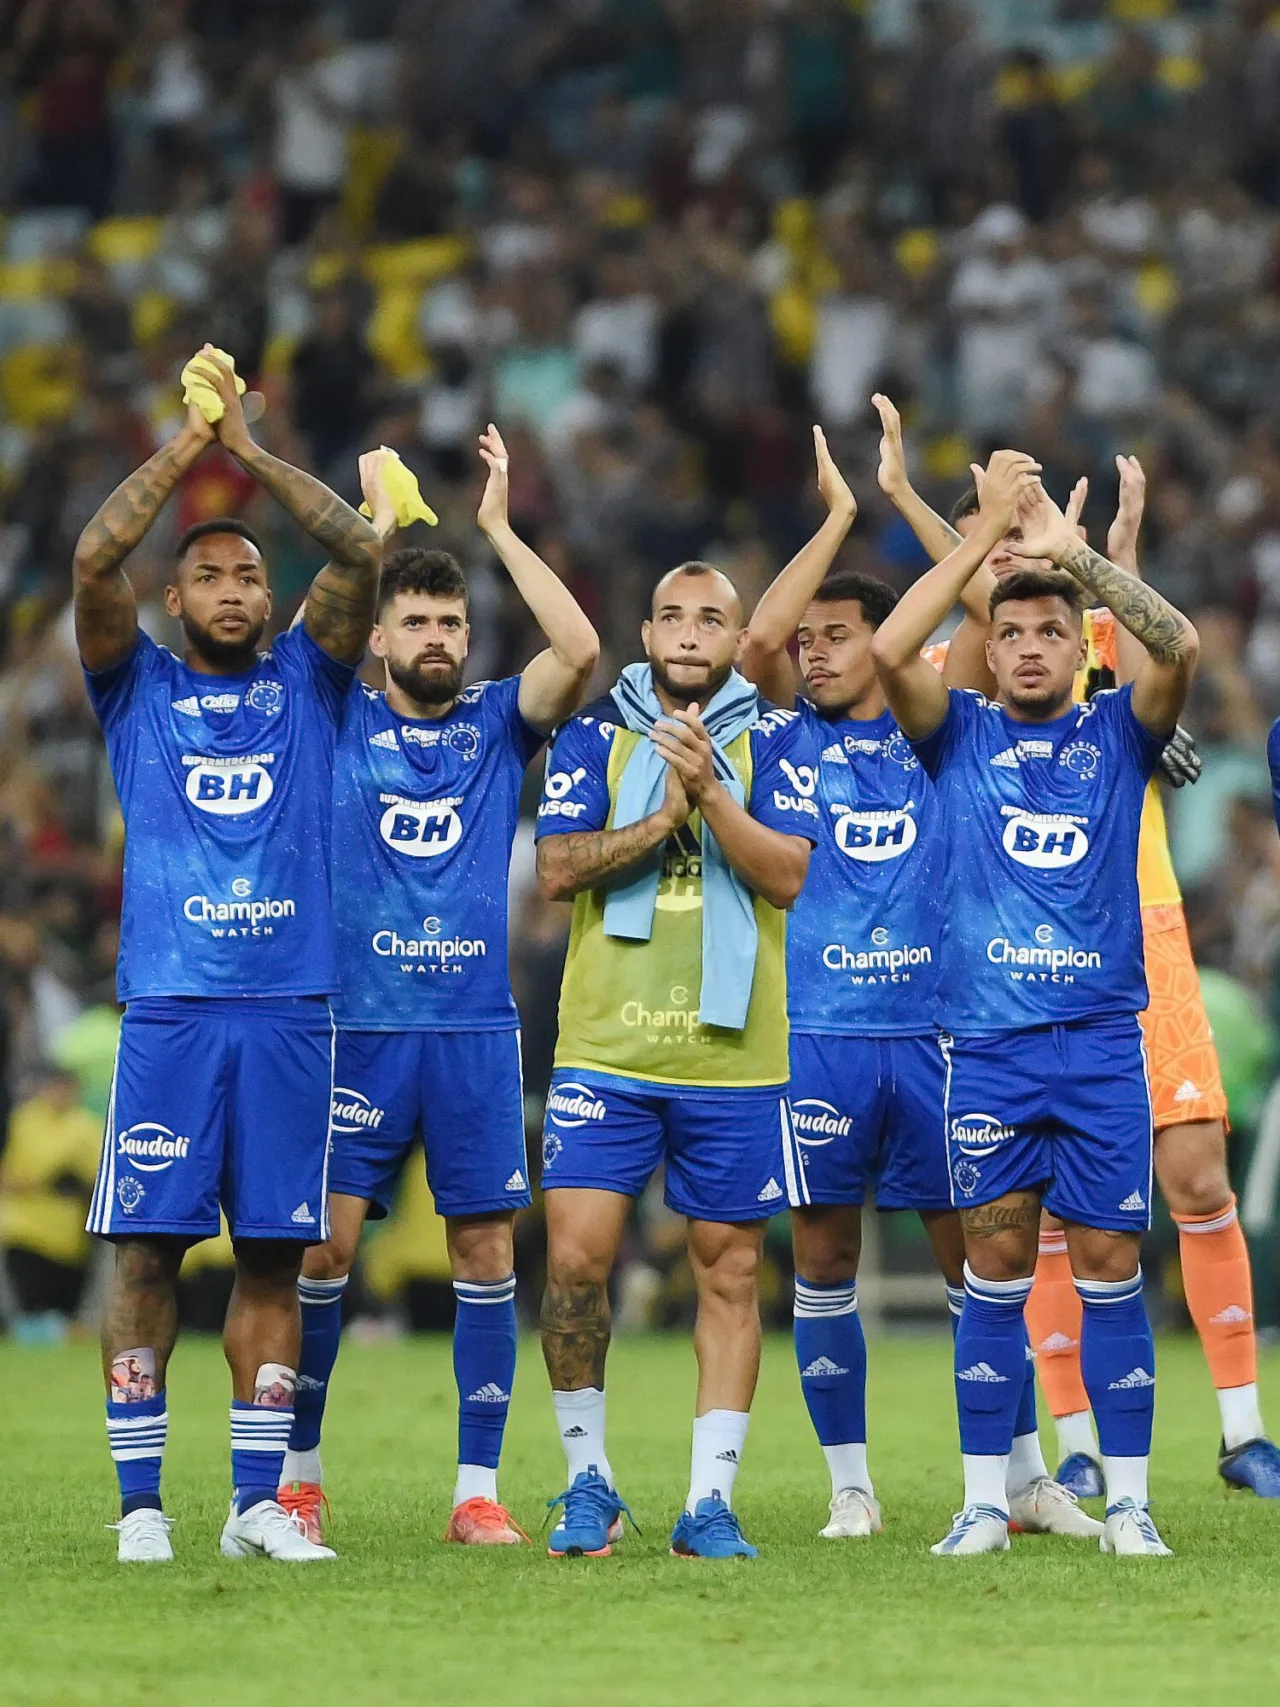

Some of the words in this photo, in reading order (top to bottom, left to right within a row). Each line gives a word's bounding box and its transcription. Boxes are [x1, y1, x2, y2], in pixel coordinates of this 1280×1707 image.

[181, 752, 276, 768] SUPERMERCADOS
[1058, 740, 1102, 766] CRUZEIRO
[196, 772, 262, 801] BH
[538, 799, 588, 818] user
[389, 813, 453, 843] BH
[844, 819, 905, 848] BH
[1011, 824, 1077, 857] BH
[183, 895, 296, 927] Champion
[211, 926, 274, 938] WATCH
[372, 930, 486, 963] Champion
[822, 944, 933, 974] Champion
[986, 936, 1102, 974] Champion
[400, 964, 463, 973] WATCH
[850, 972, 911, 985] WATCH
[1009, 970, 1075, 984] WATCH
[620, 1001, 700, 1034] Champ
[646, 1035, 712, 1044] WATCH
[330, 1100, 386, 1130] udali
[790, 1109, 853, 1137] audali
[117, 1130, 191, 1158] Saudali
